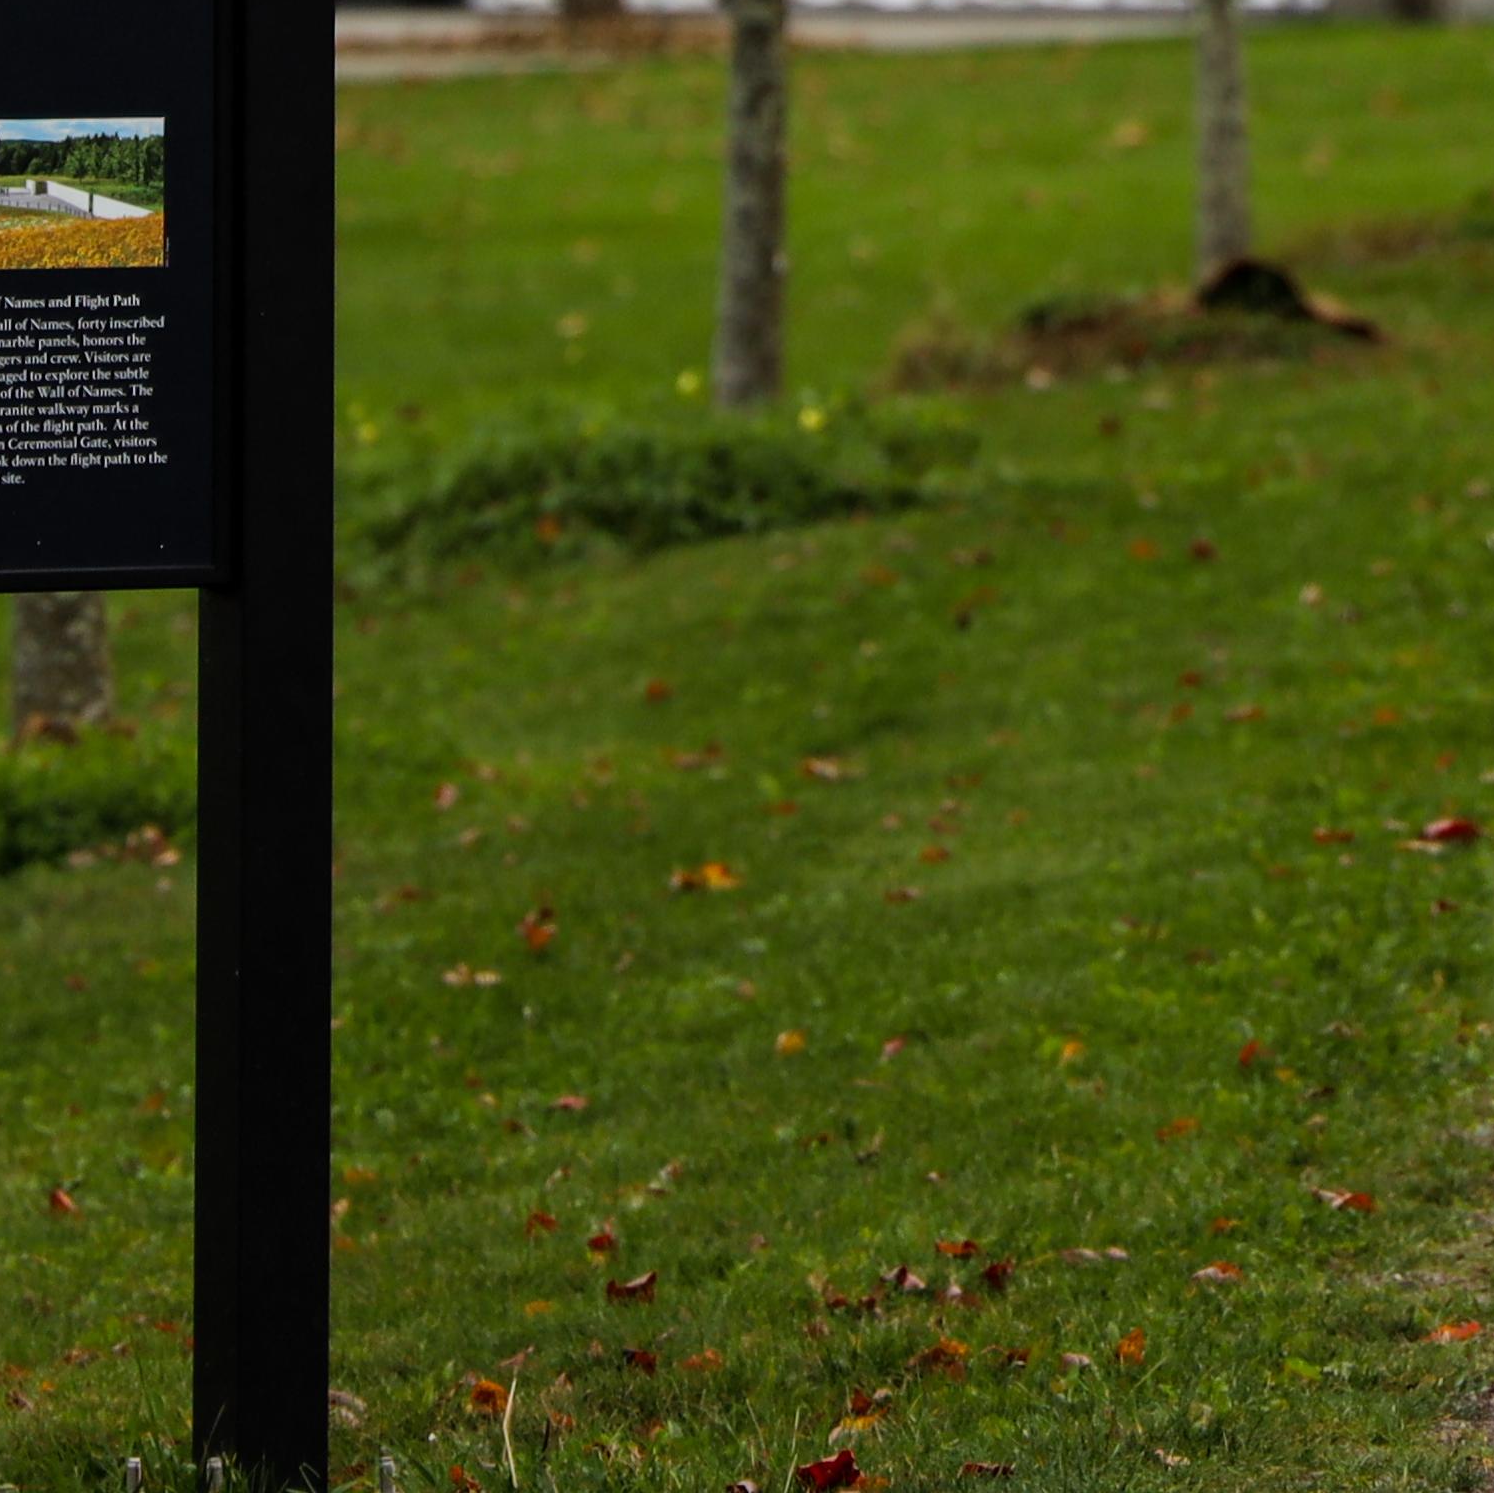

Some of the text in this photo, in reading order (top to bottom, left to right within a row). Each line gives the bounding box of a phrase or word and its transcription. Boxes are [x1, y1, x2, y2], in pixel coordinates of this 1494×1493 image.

[4, 296, 45, 309] Names
[48, 295, 71, 308] and
[75, 294, 110, 308] Flight
[113, 294, 140, 307] Path
[14, 318, 29, 331] of
[30, 317, 75, 332] Names,
[77, 316, 107, 333] forty
[109, 315, 165, 329] inscribed
